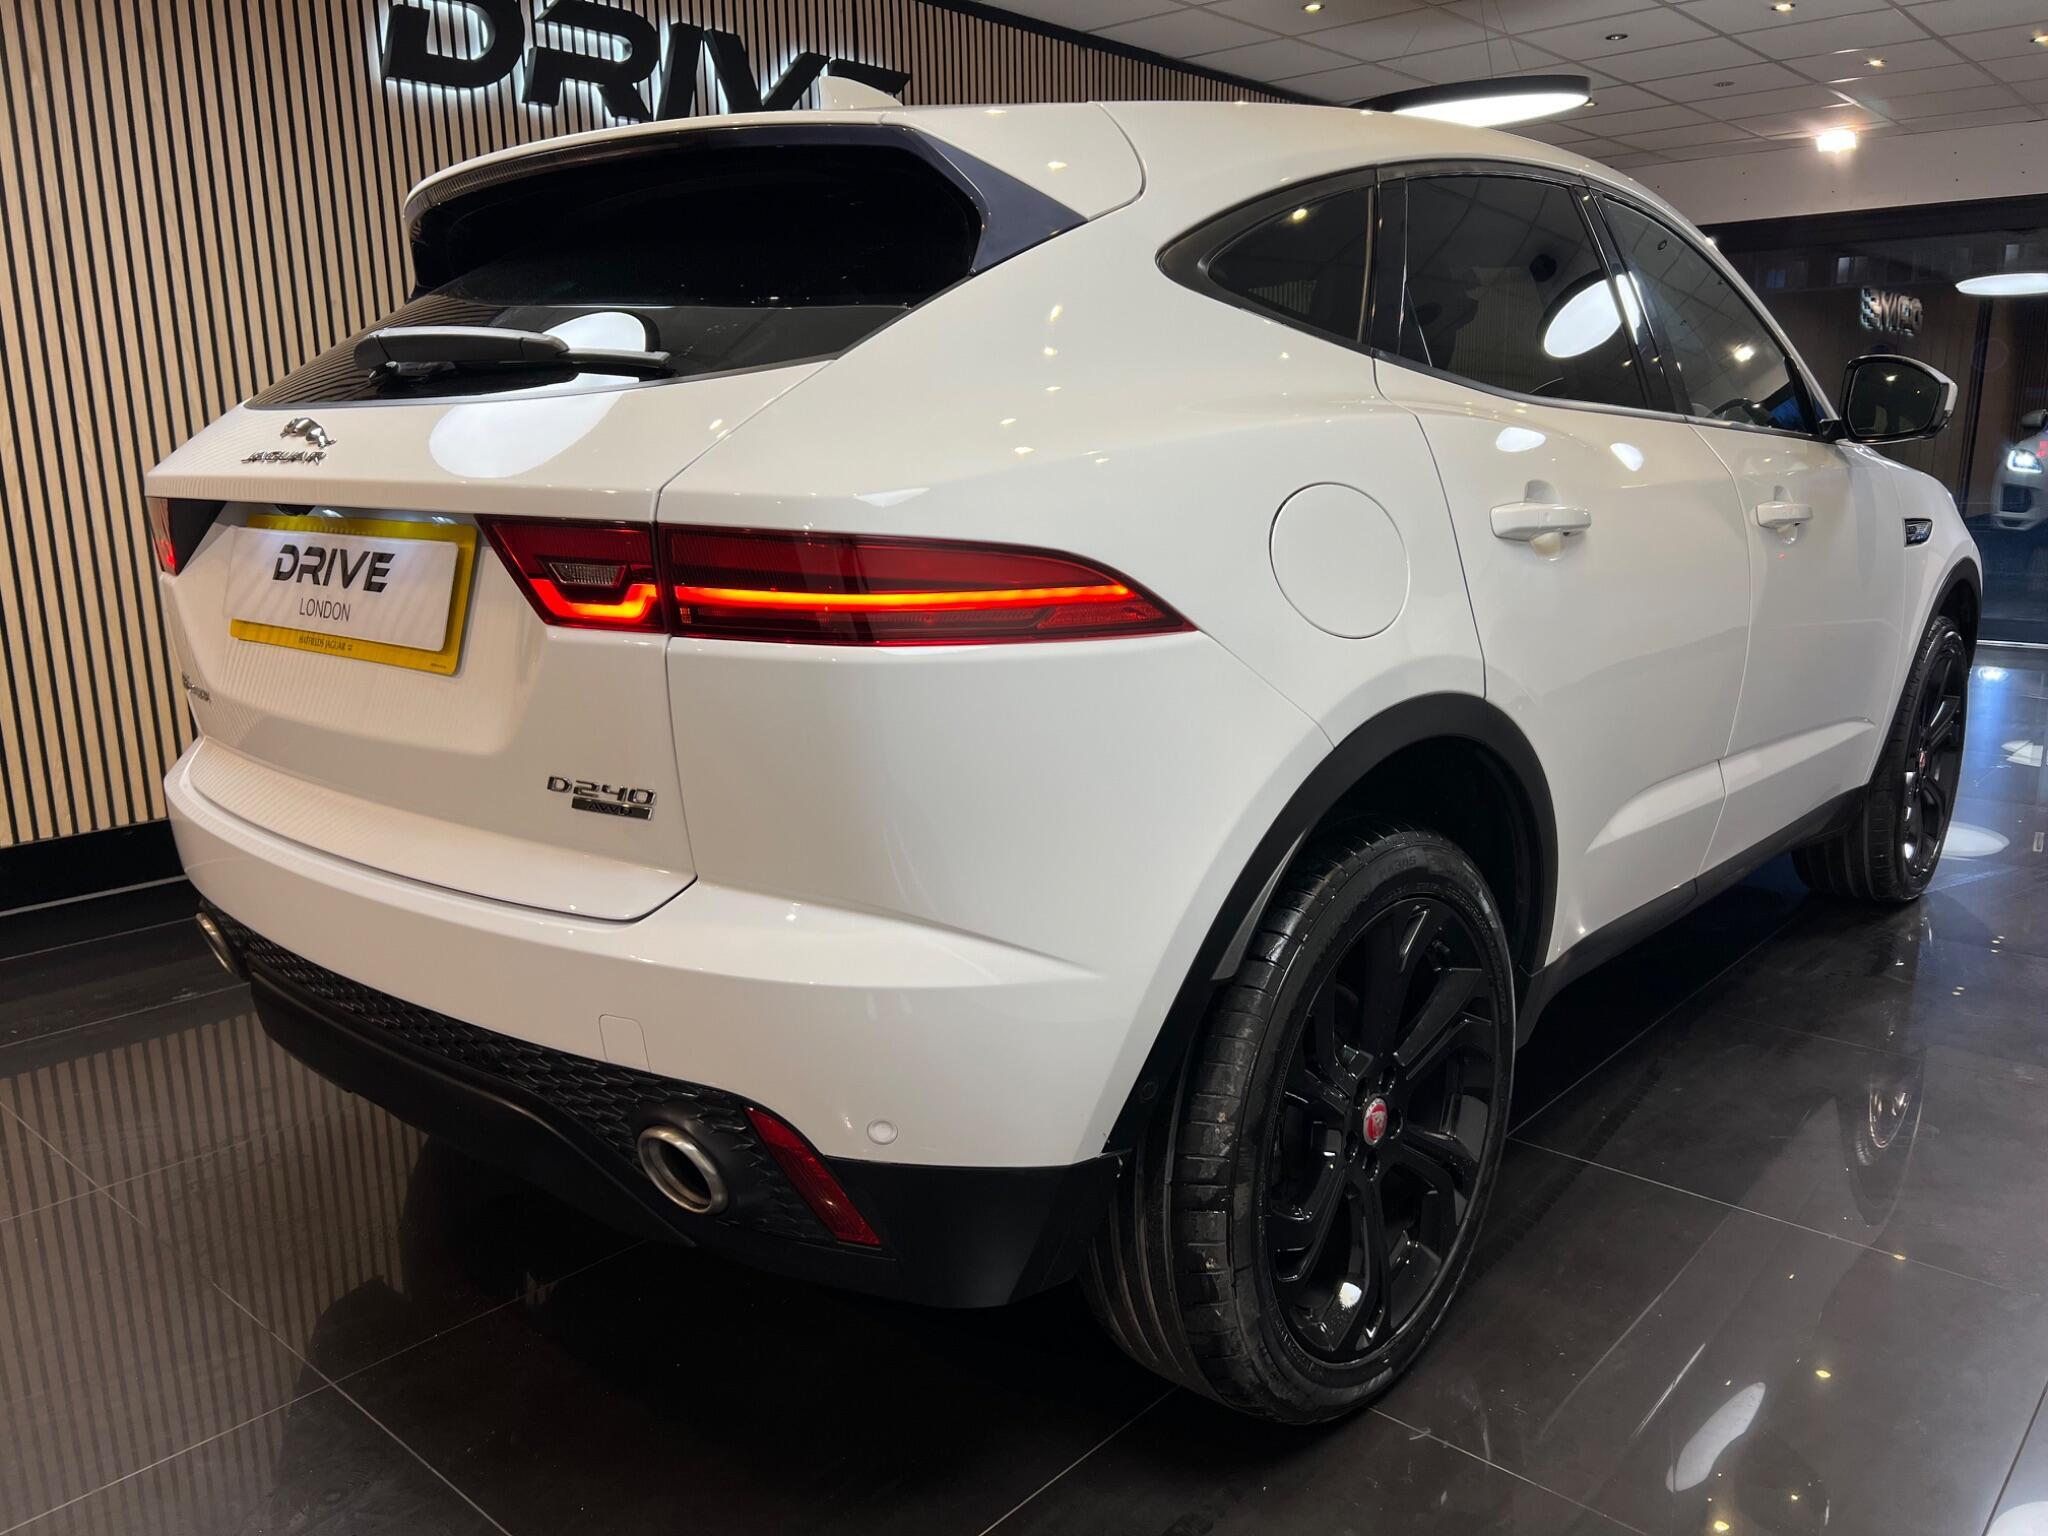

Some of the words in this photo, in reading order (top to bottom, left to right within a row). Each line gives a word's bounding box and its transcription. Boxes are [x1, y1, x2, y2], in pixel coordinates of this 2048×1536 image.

[240, 450, 327, 466] JAGUAR
[271, 543, 396, 593] DRIVE
[299, 597, 352, 622] LONDON
[546, 775, 657, 806] D240
